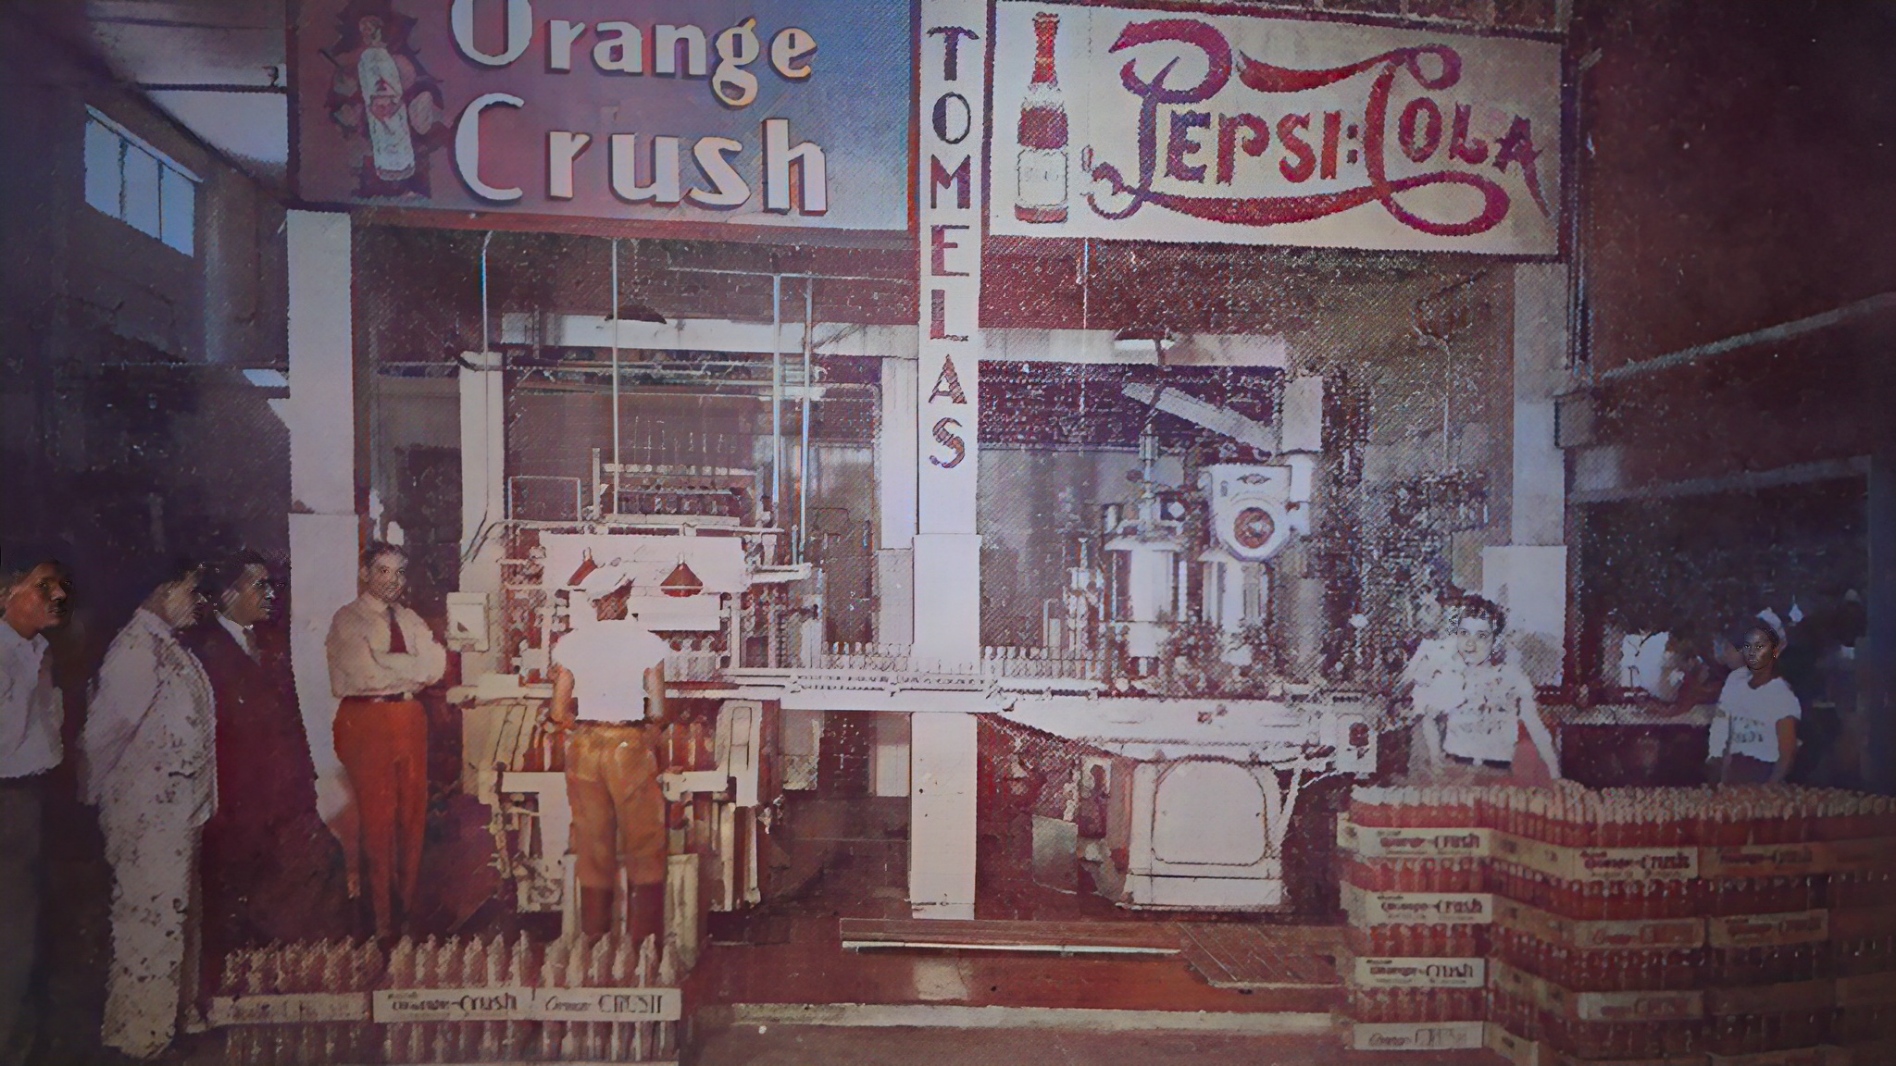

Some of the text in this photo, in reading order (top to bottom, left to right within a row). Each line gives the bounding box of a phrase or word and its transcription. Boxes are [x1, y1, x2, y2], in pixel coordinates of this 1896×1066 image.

[450, 0, 818, 107] Orange
[453, 92, 828, 213] Crush
[927, 26, 980, 470] TOMELAS
